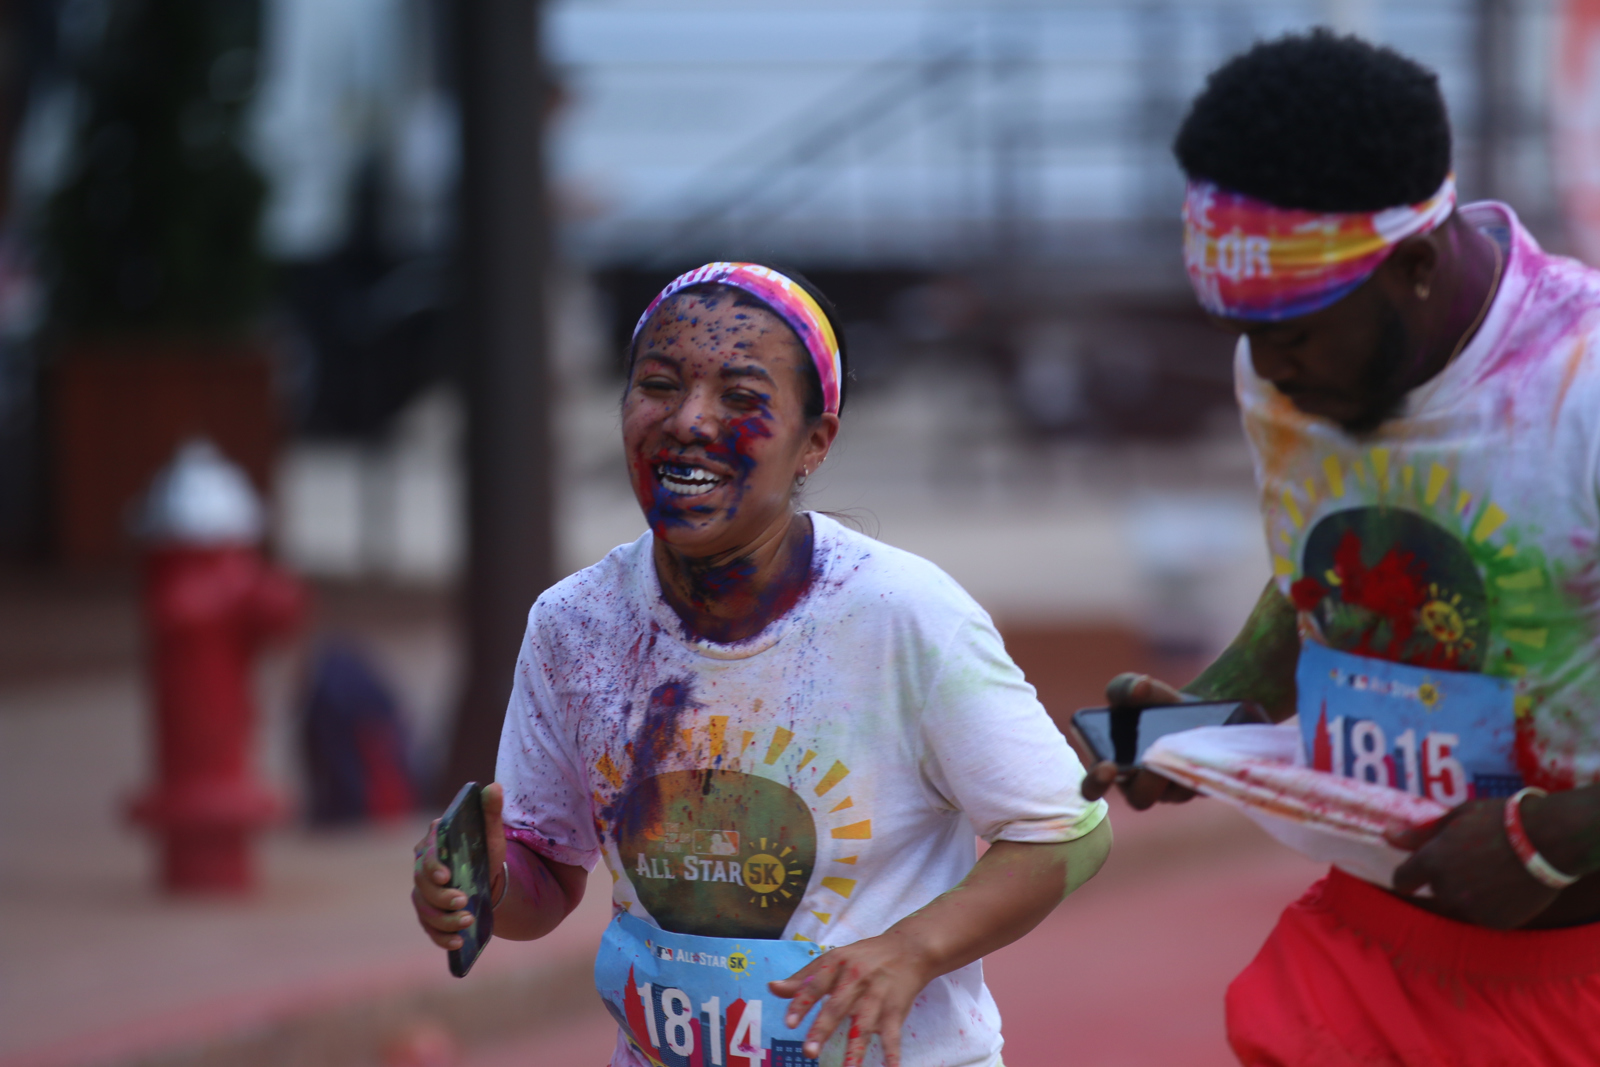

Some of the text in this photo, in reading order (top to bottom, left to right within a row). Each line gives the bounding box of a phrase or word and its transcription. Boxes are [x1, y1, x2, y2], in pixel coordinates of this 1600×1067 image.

[1328, 715, 1468, 807] 1815
[683, 855, 744, 886] STAR
[748, 863, 779, 885] 5K
[729, 957, 745, 969] 5K
[637, 982, 766, 1066] 1814
